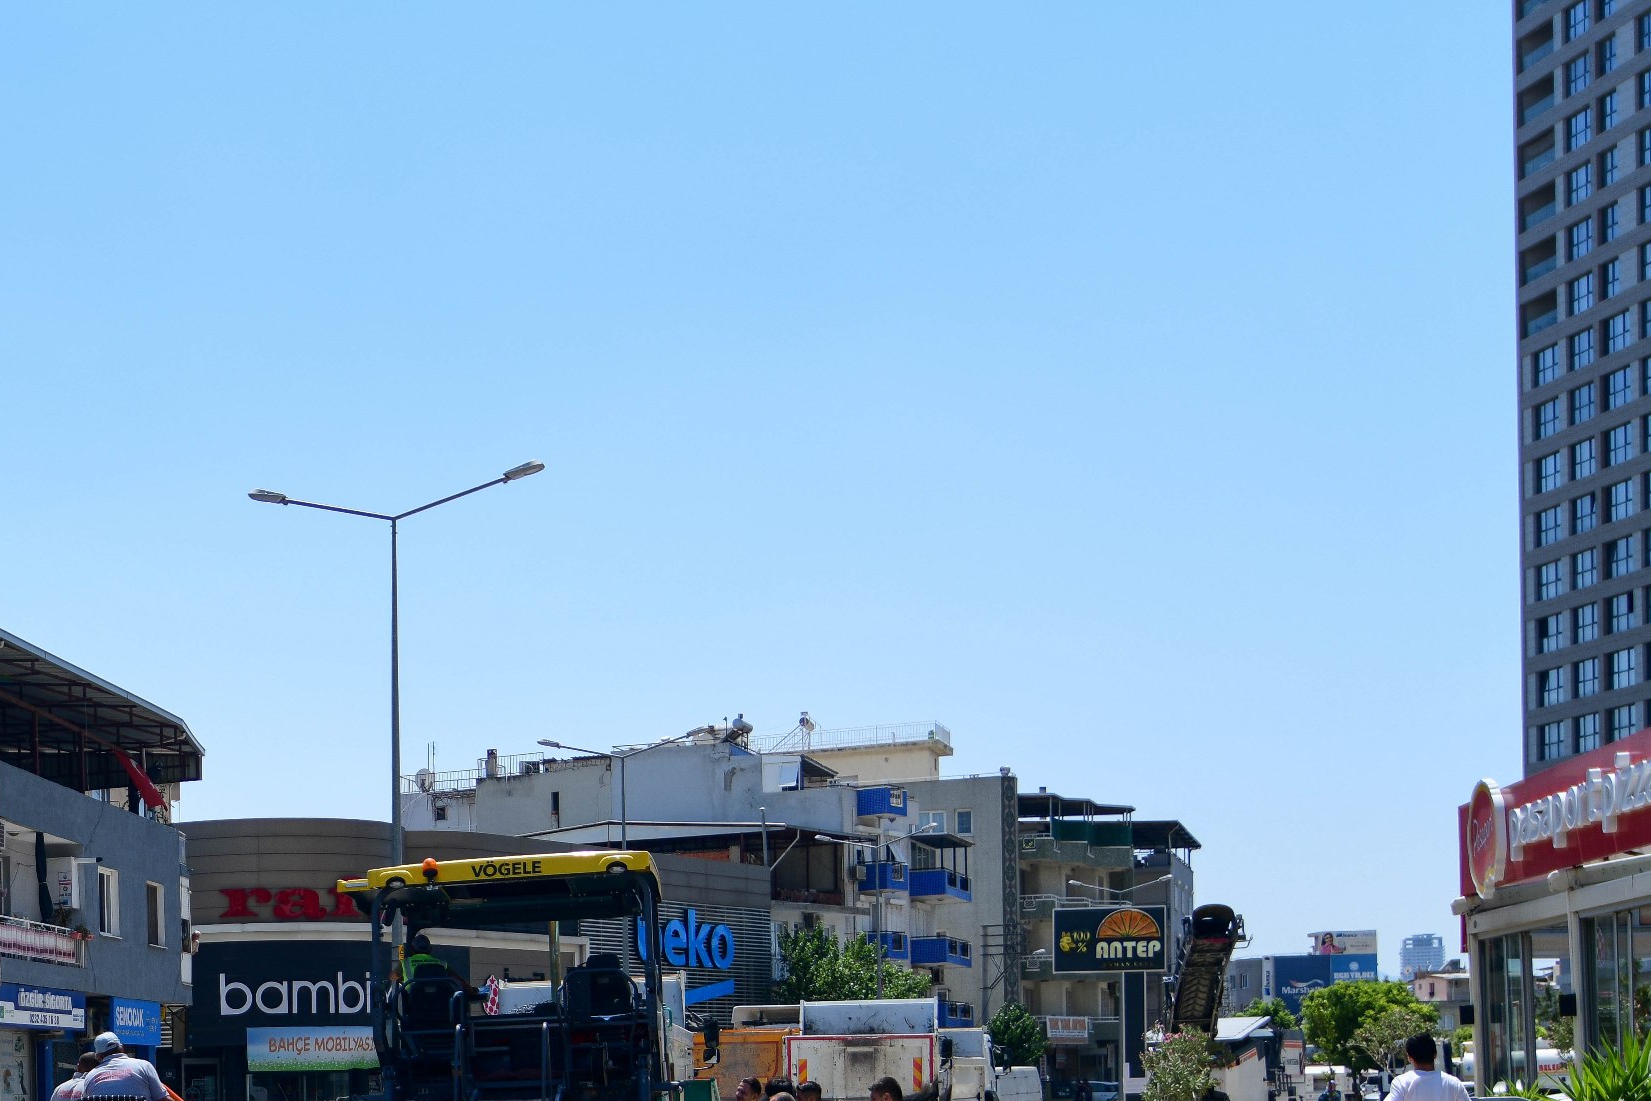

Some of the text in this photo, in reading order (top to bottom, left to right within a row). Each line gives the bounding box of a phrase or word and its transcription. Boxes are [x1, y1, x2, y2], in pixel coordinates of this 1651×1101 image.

[1509, 751, 1651, 862] pasaport pizz
[471, 859, 543, 879] VÖGELE
[1072, 930, 1091, 942] 100
[1095, 940, 1162, 959] ANTEP
[17, 987, 73, 1011] ÖZGÜR SİGORTA
[219, 971, 371, 1016] bambi
[269, 1037, 310, 1055] BAHÇE
